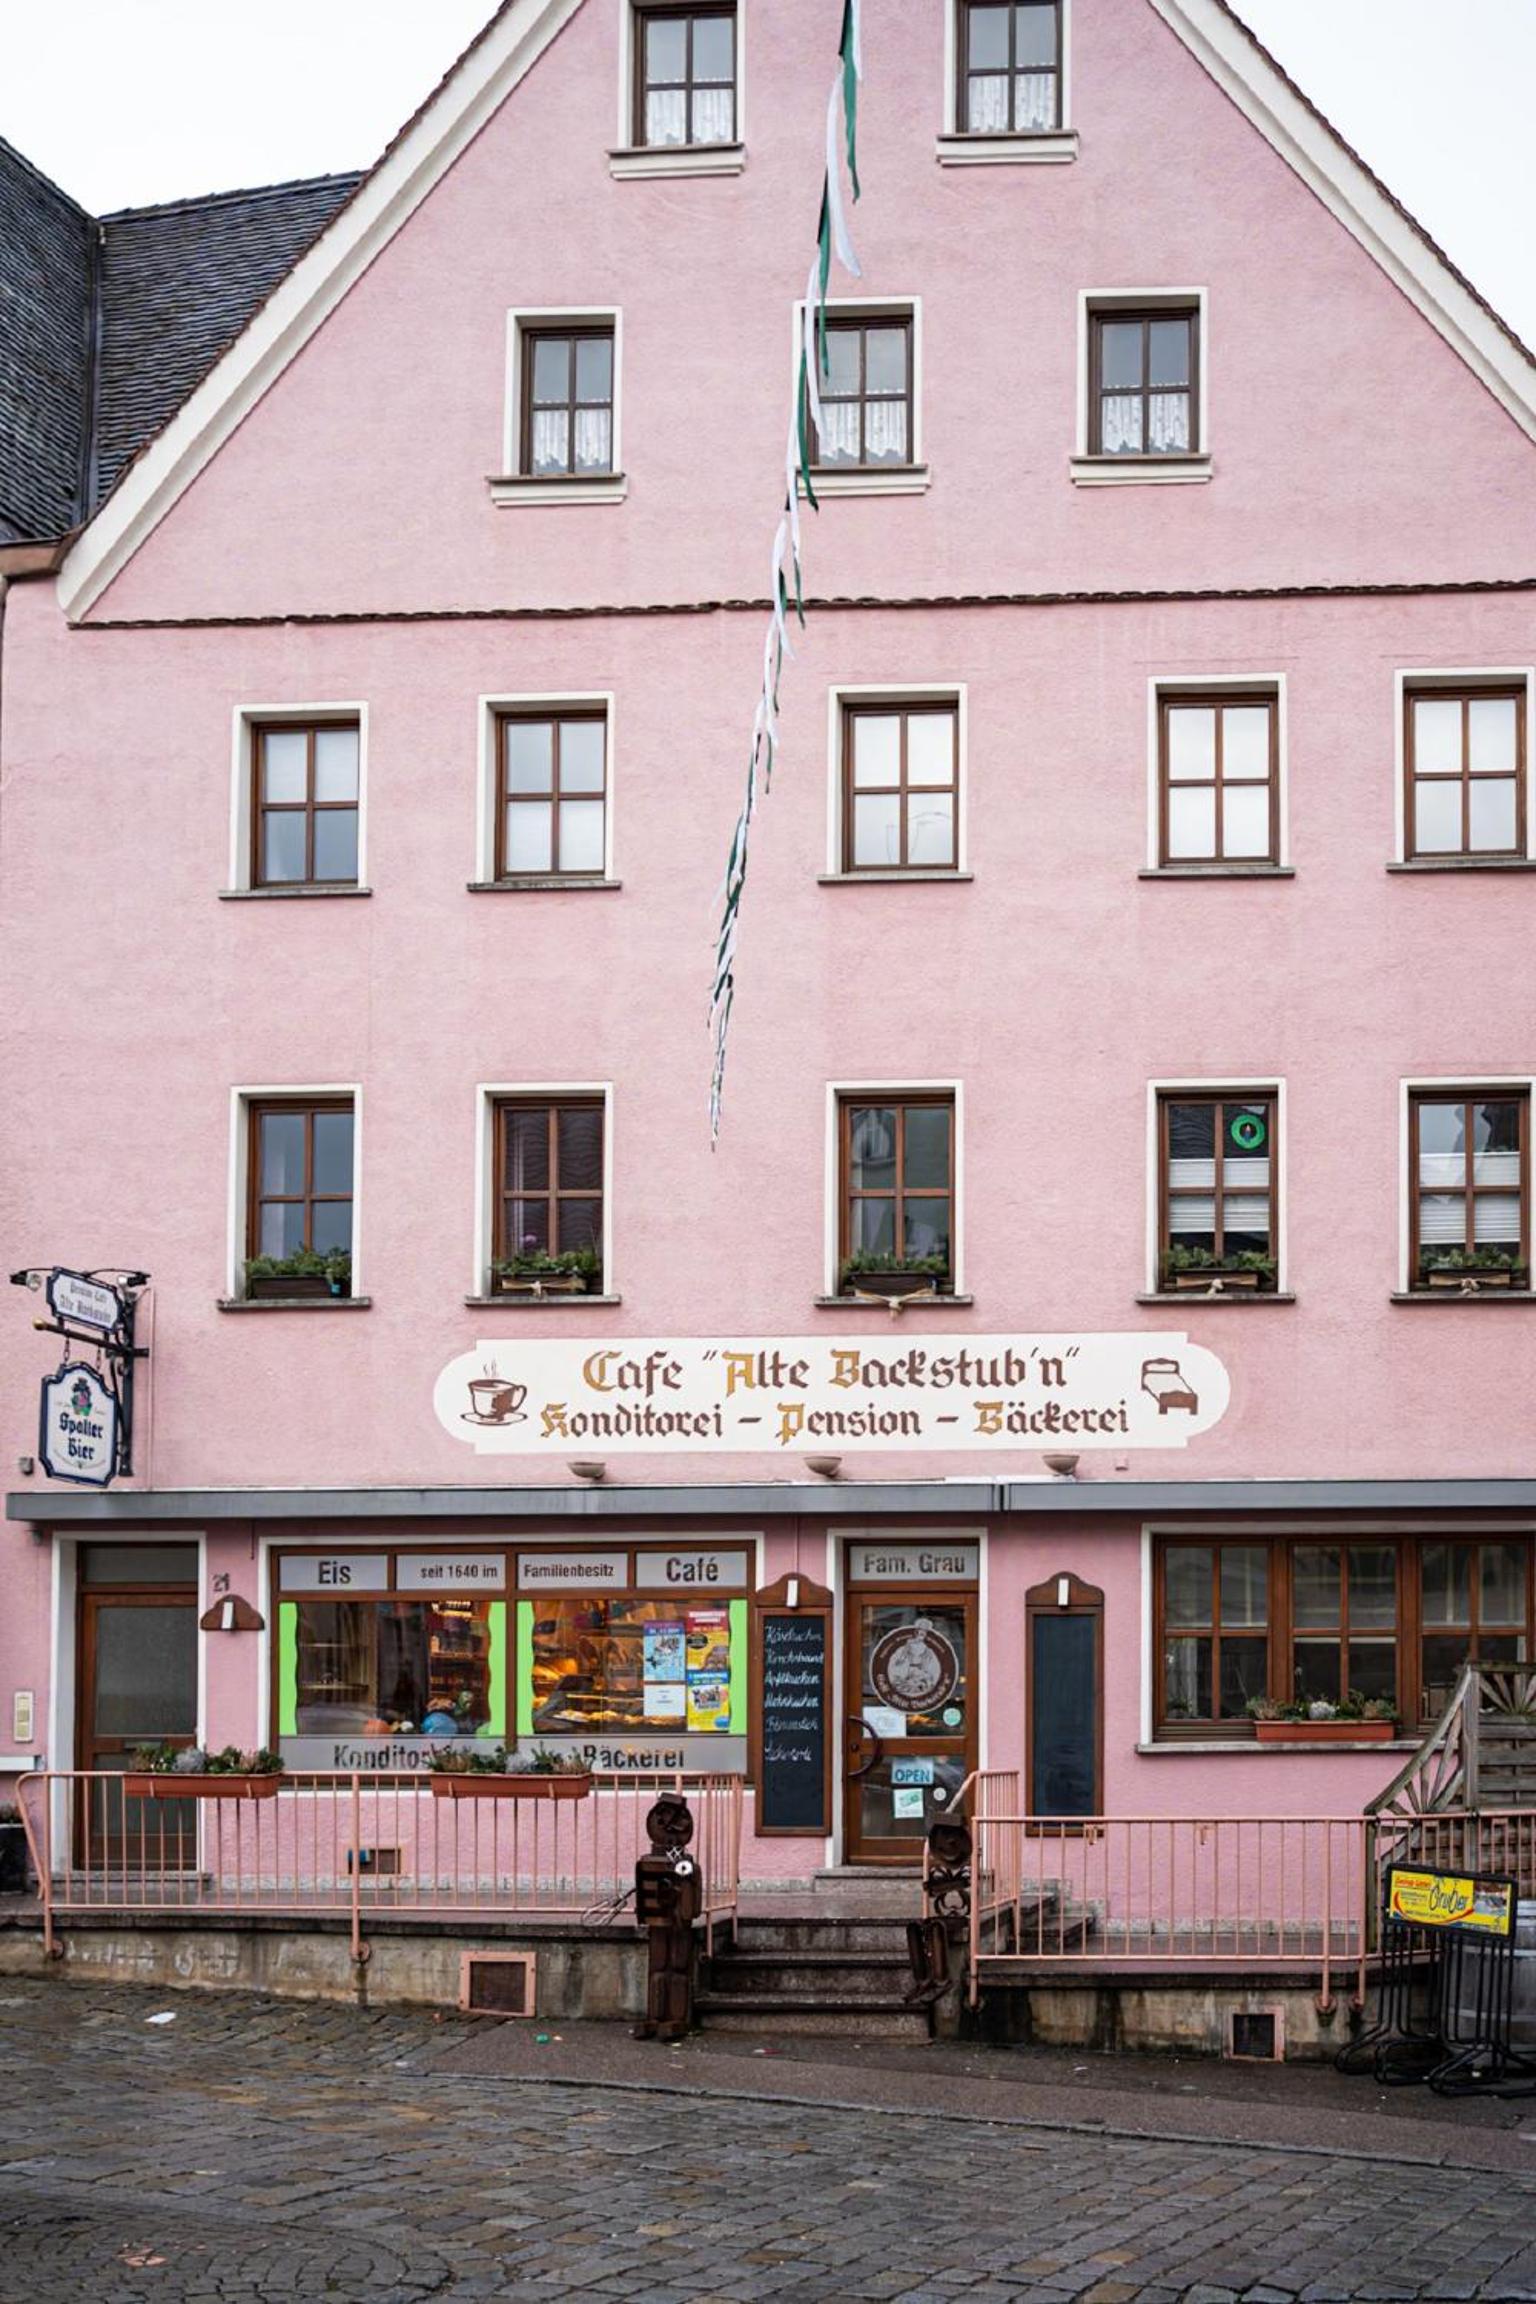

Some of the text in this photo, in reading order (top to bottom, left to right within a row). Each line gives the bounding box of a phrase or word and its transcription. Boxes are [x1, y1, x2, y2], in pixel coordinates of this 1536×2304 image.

[583, 1351, 683, 1398] Cafe
[540, 1402, 723, 1438] Konditorei
[775, 1402, 922, 1446] Pension
[973, 1400, 1129, 1435] Bäckerei
[67, 1437, 95, 1460] Bier
[318, 1561, 351, 1585] Eis
[421, 1565, 498, 1578] seit 1640 im
[523, 1563, 615, 1578] Familienbesitz
[666, 1556, 719, 1582] Café
[864, 1552, 965, 1574] Fam. Grau
[334, 1744, 438, 1769] Kondito
[583, 1744, 685, 1769] Bäckerei
[894, 1768, 931, 1783] OPEN
